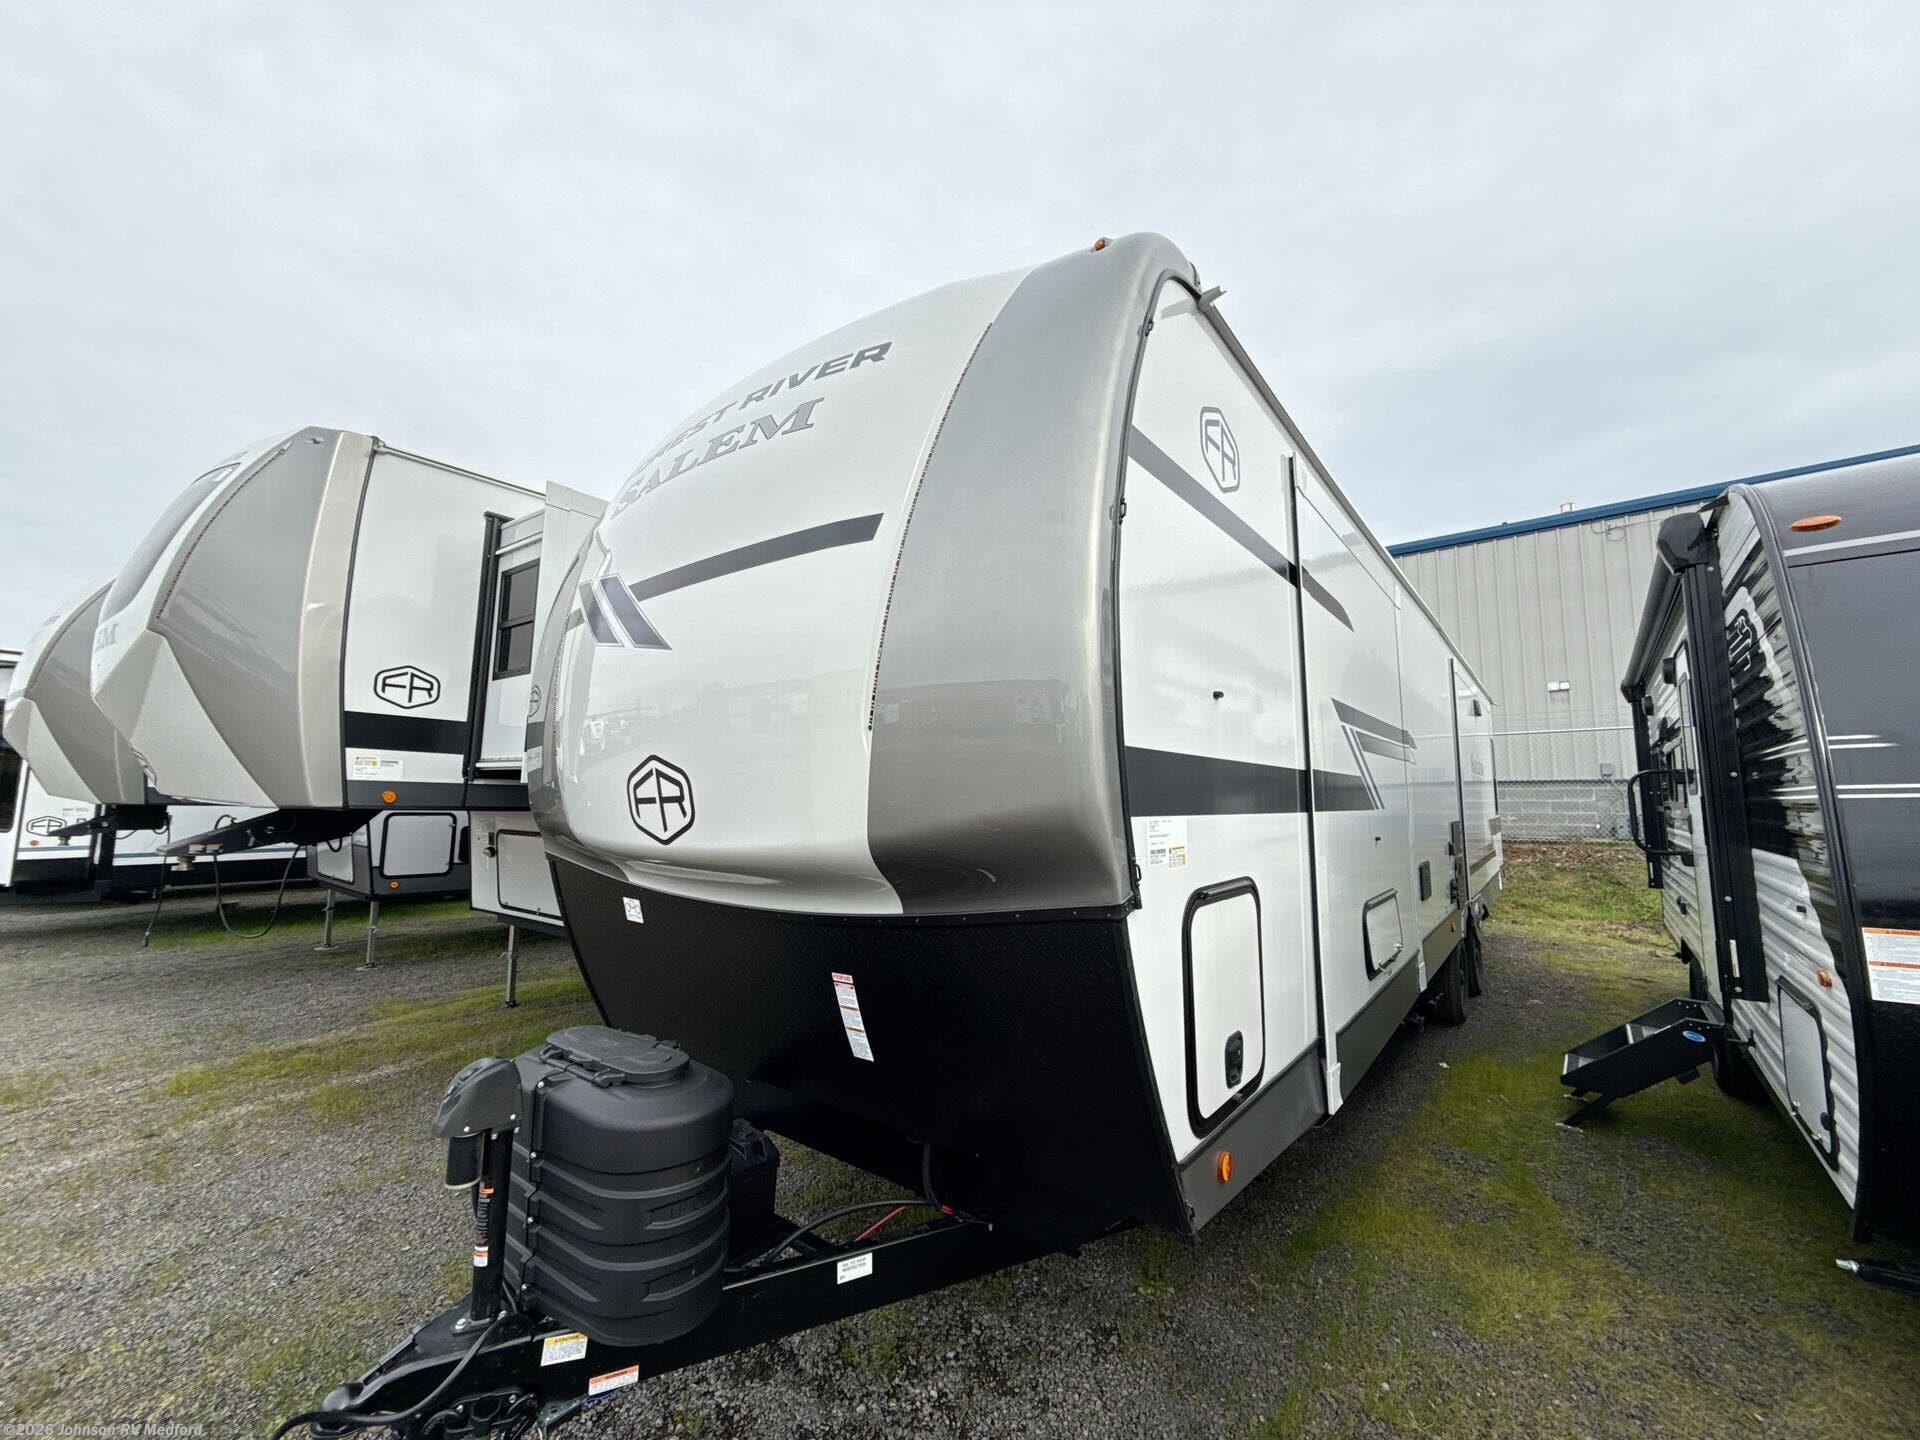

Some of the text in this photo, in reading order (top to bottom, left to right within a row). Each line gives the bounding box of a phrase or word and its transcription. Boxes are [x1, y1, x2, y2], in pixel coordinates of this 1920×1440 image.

[739, 341, 892, 410] RIVER
[611, 397, 824, 520] SALEM
[381, 671, 434, 703] FR
[633, 767, 688, 833] FR
